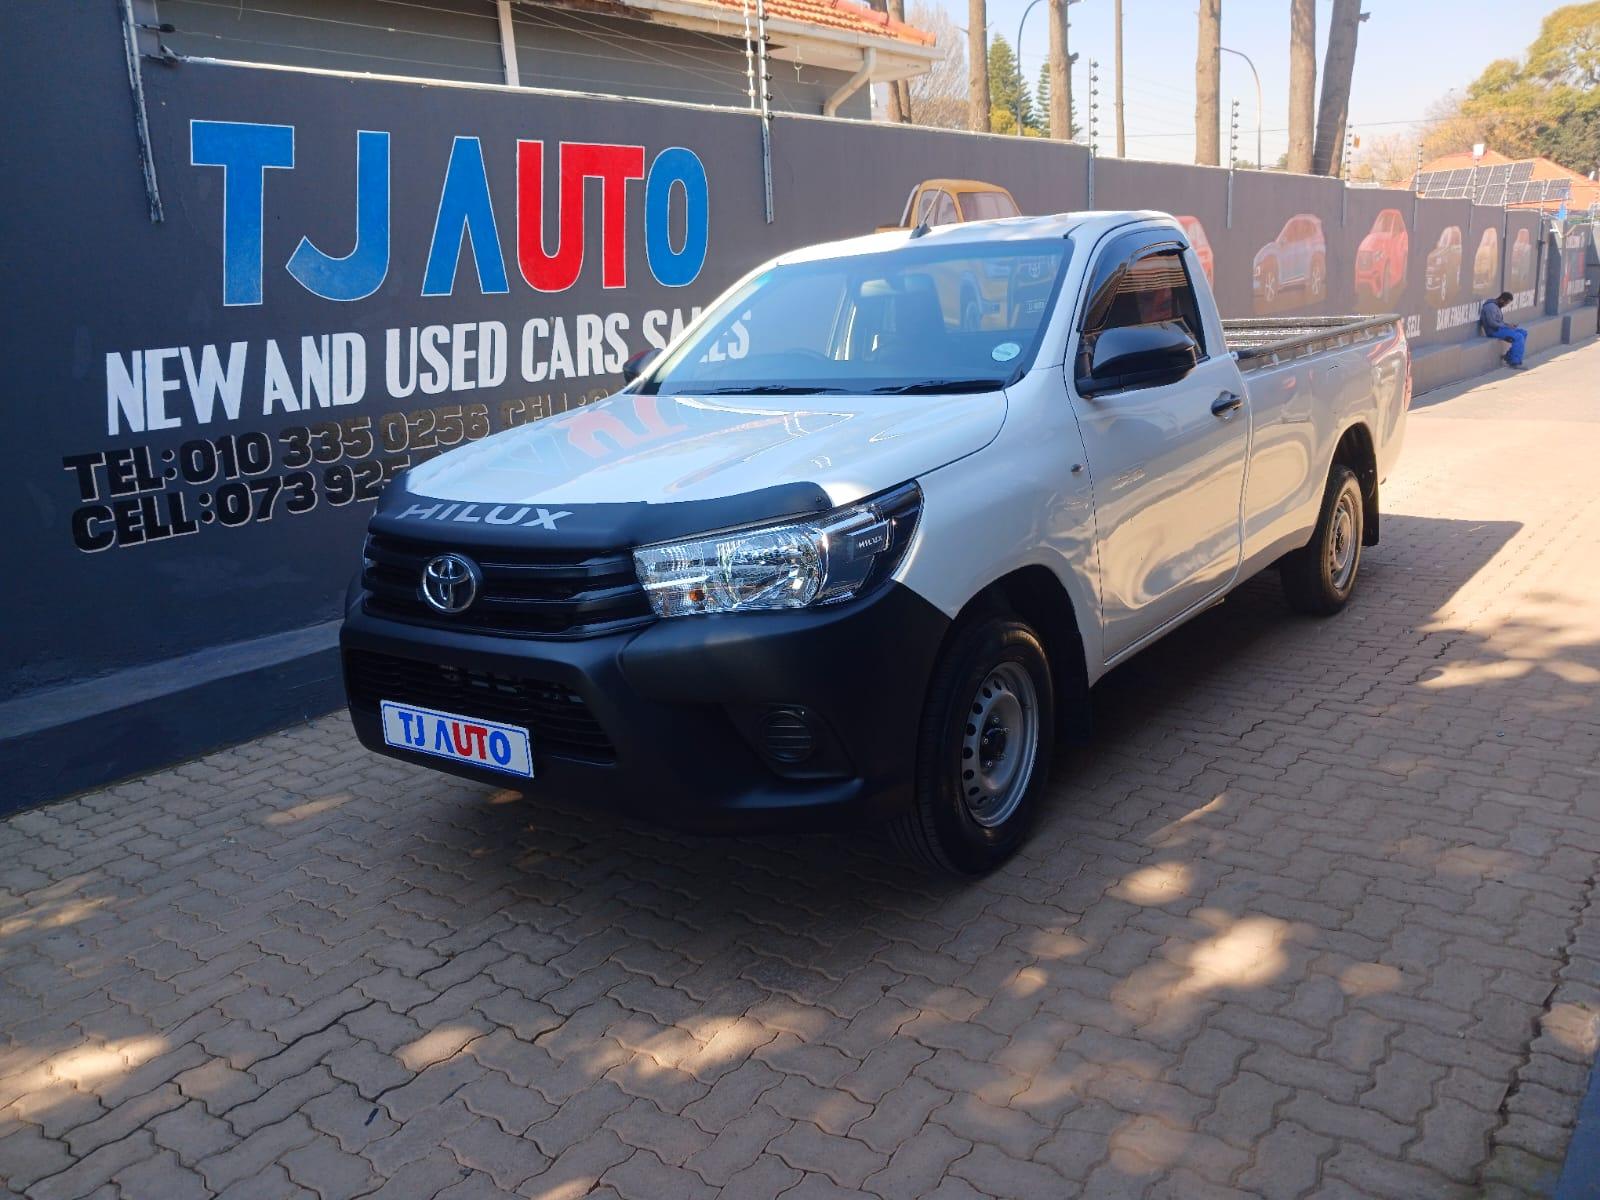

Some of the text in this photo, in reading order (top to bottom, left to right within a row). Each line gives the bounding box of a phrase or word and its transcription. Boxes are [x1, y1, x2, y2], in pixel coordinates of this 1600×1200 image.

[190, 119, 709, 306] TJ AUTO
[1406, 314, 1421, 338] SELL
[106, 306, 752, 436] NEW AND USED CARS SAS
[278, 416, 373, 469] 335
[380, 403, 491, 453] 0256
[395, 503, 574, 530] HILUX
[858, 535, 883, 548] HILUX
[398, 711, 512, 766] TJ AUTO
